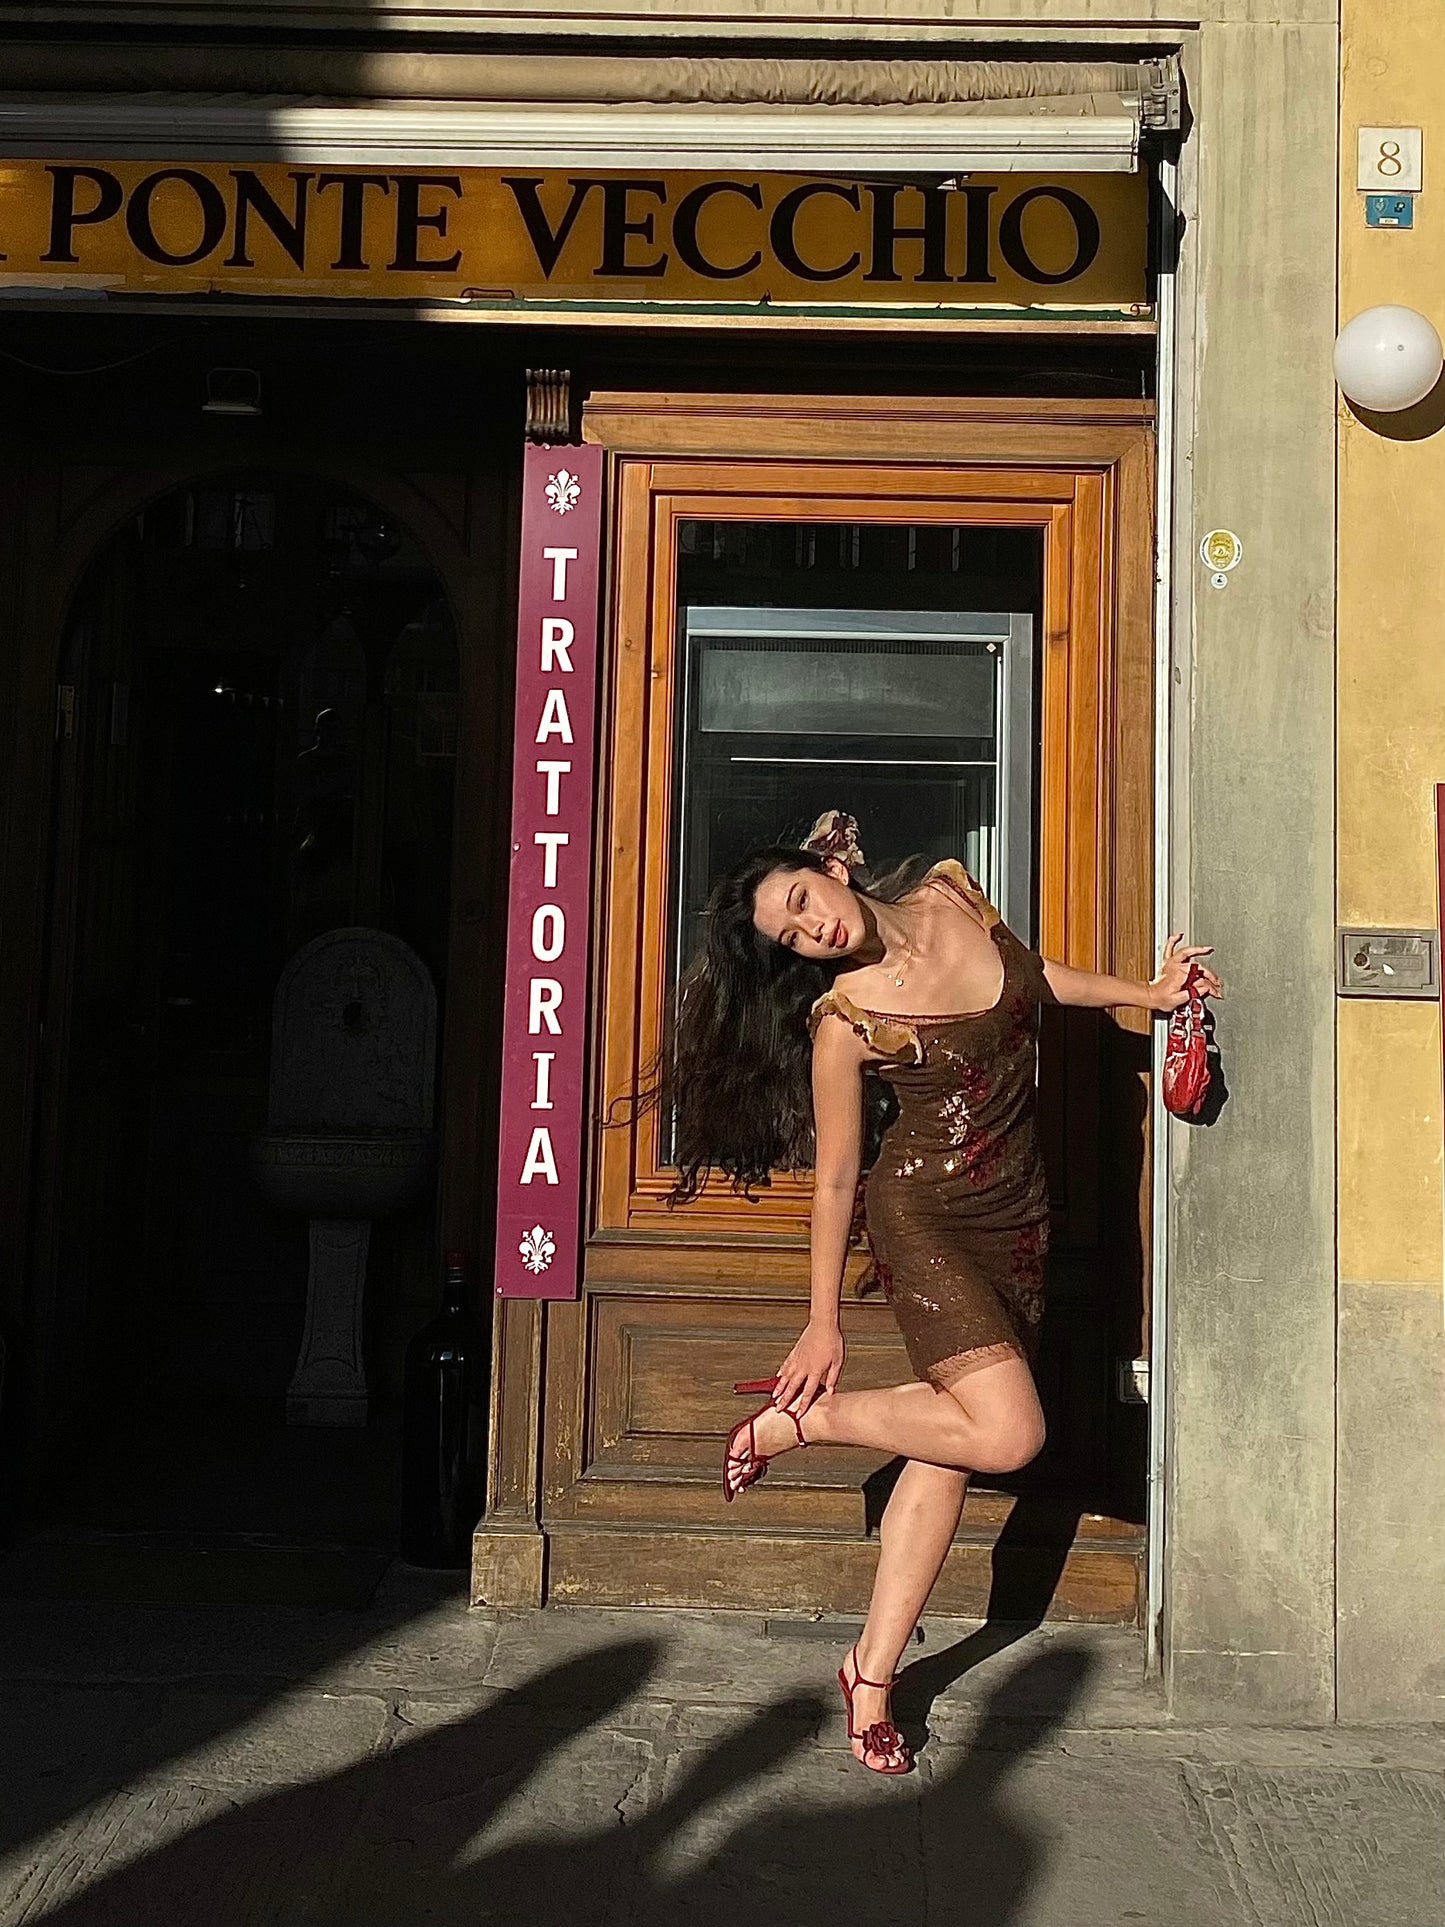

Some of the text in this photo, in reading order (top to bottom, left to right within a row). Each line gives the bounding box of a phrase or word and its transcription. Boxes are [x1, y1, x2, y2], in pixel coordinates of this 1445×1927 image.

[1377, 140, 1402, 176] 8
[39, 165, 1100, 285] PONTE VECCHIO
[519, 547, 578, 1185] TRATTORIA
